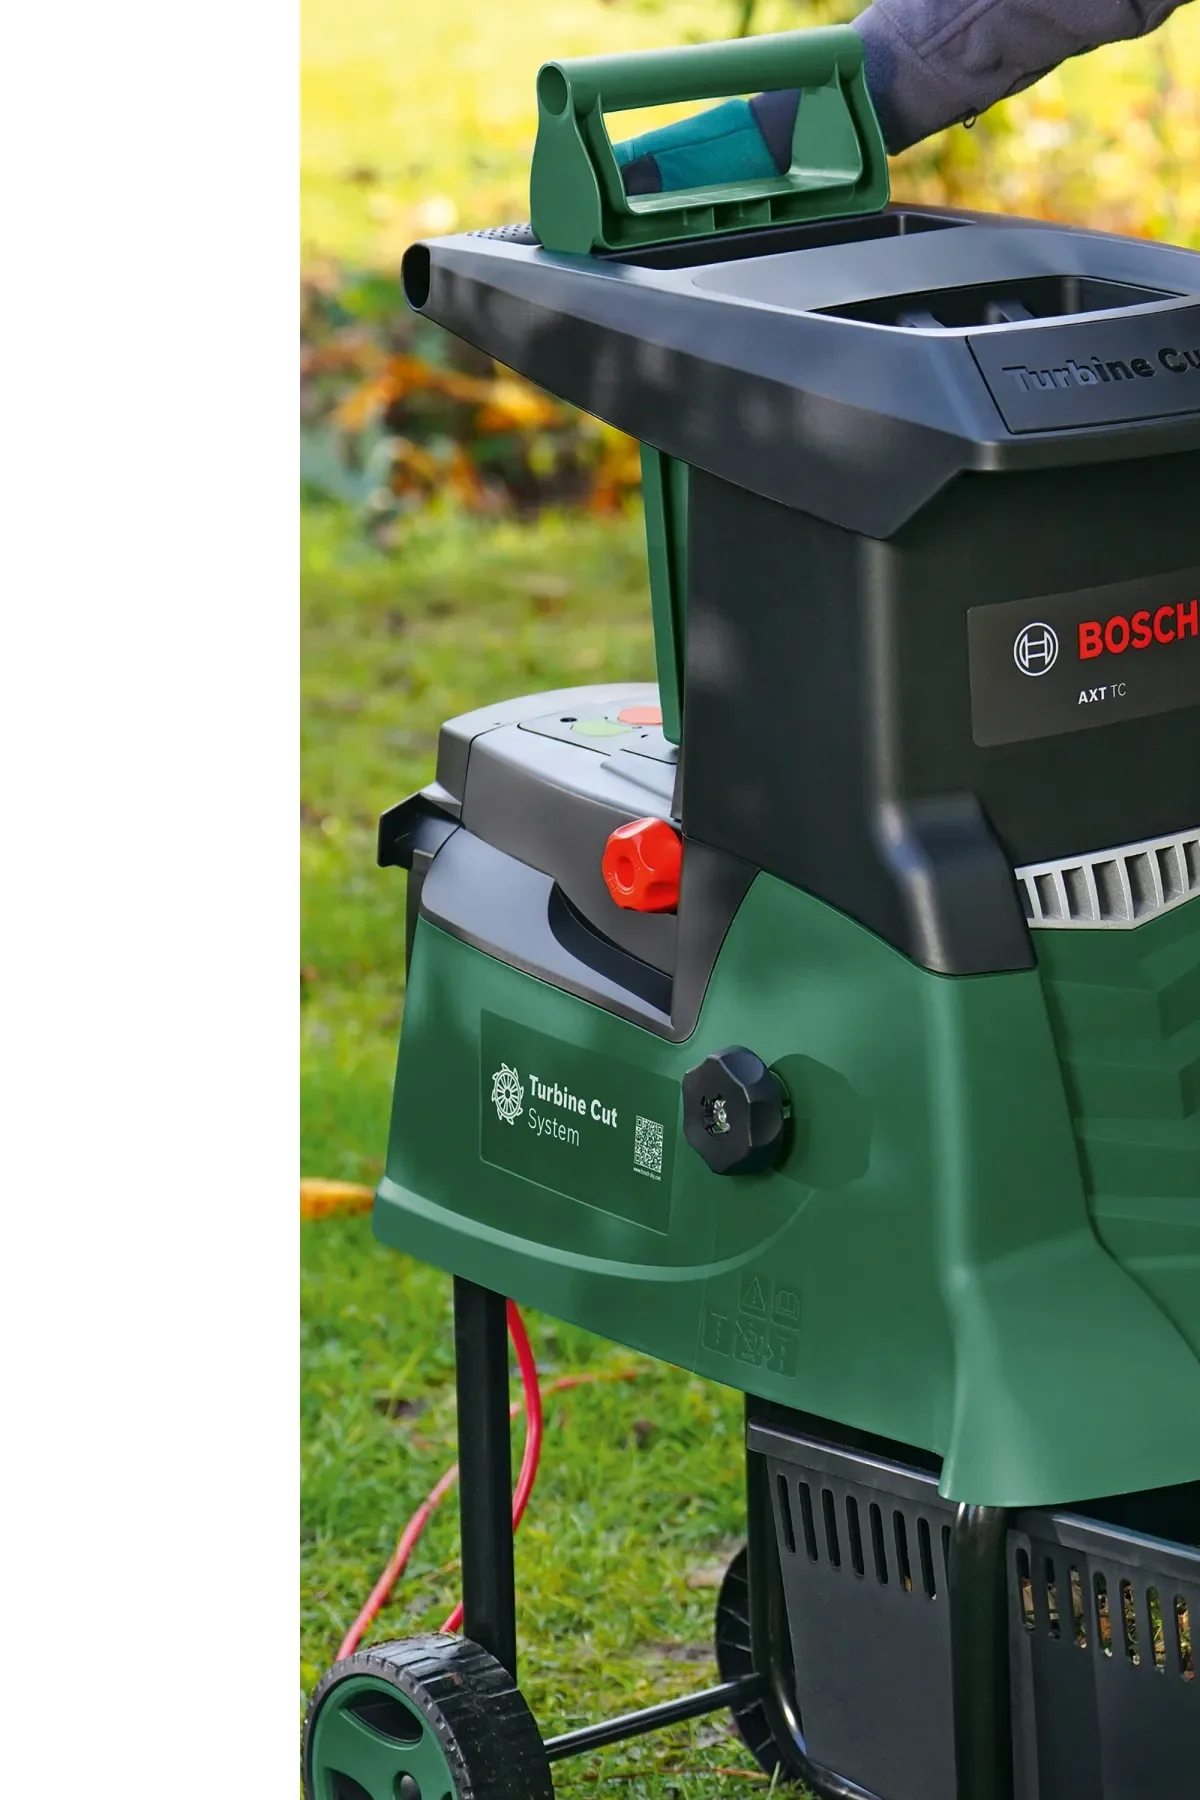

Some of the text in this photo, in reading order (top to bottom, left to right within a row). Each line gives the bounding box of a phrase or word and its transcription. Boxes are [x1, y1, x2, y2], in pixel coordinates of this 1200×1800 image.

[1002, 356, 1156, 393] Turbine
[1078, 599, 1199, 660] BOSCH
[1078, 682, 1127, 704] AXT TC
[529, 1074, 618, 1128] Turbine Cut
[528, 1107, 580, 1146] System
